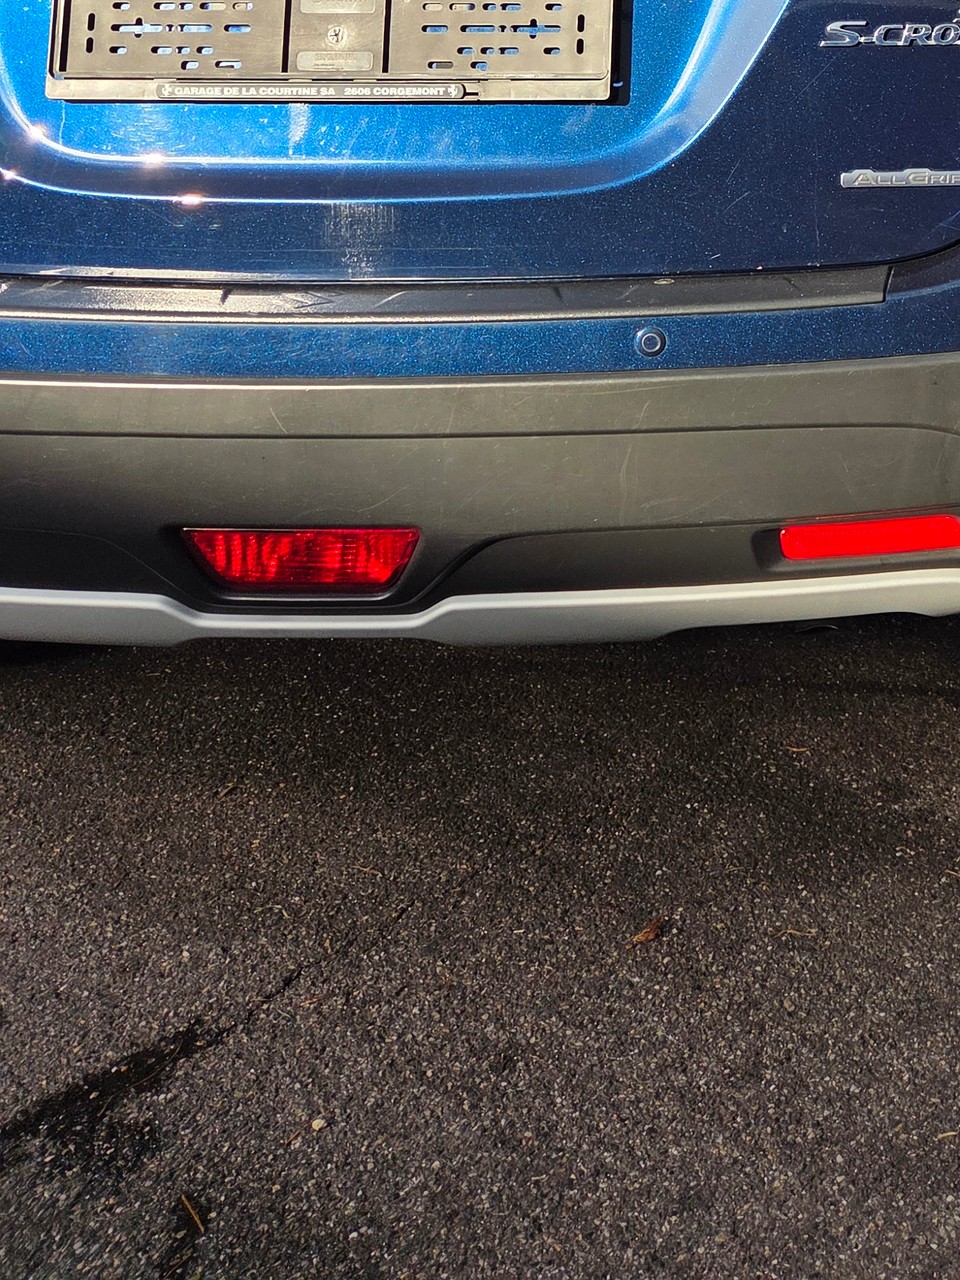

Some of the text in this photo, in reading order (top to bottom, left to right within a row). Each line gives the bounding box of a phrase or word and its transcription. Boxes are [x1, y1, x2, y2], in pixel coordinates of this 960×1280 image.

[174, 87, 222, 96] GARAGE
[223, 87, 239, 96] DE
[241, 87, 257, 96] LA
[258, 87, 317, 96] COURTINE
[320, 87, 335, 96] SA
[373, 87, 445, 96] CORGEMONT
